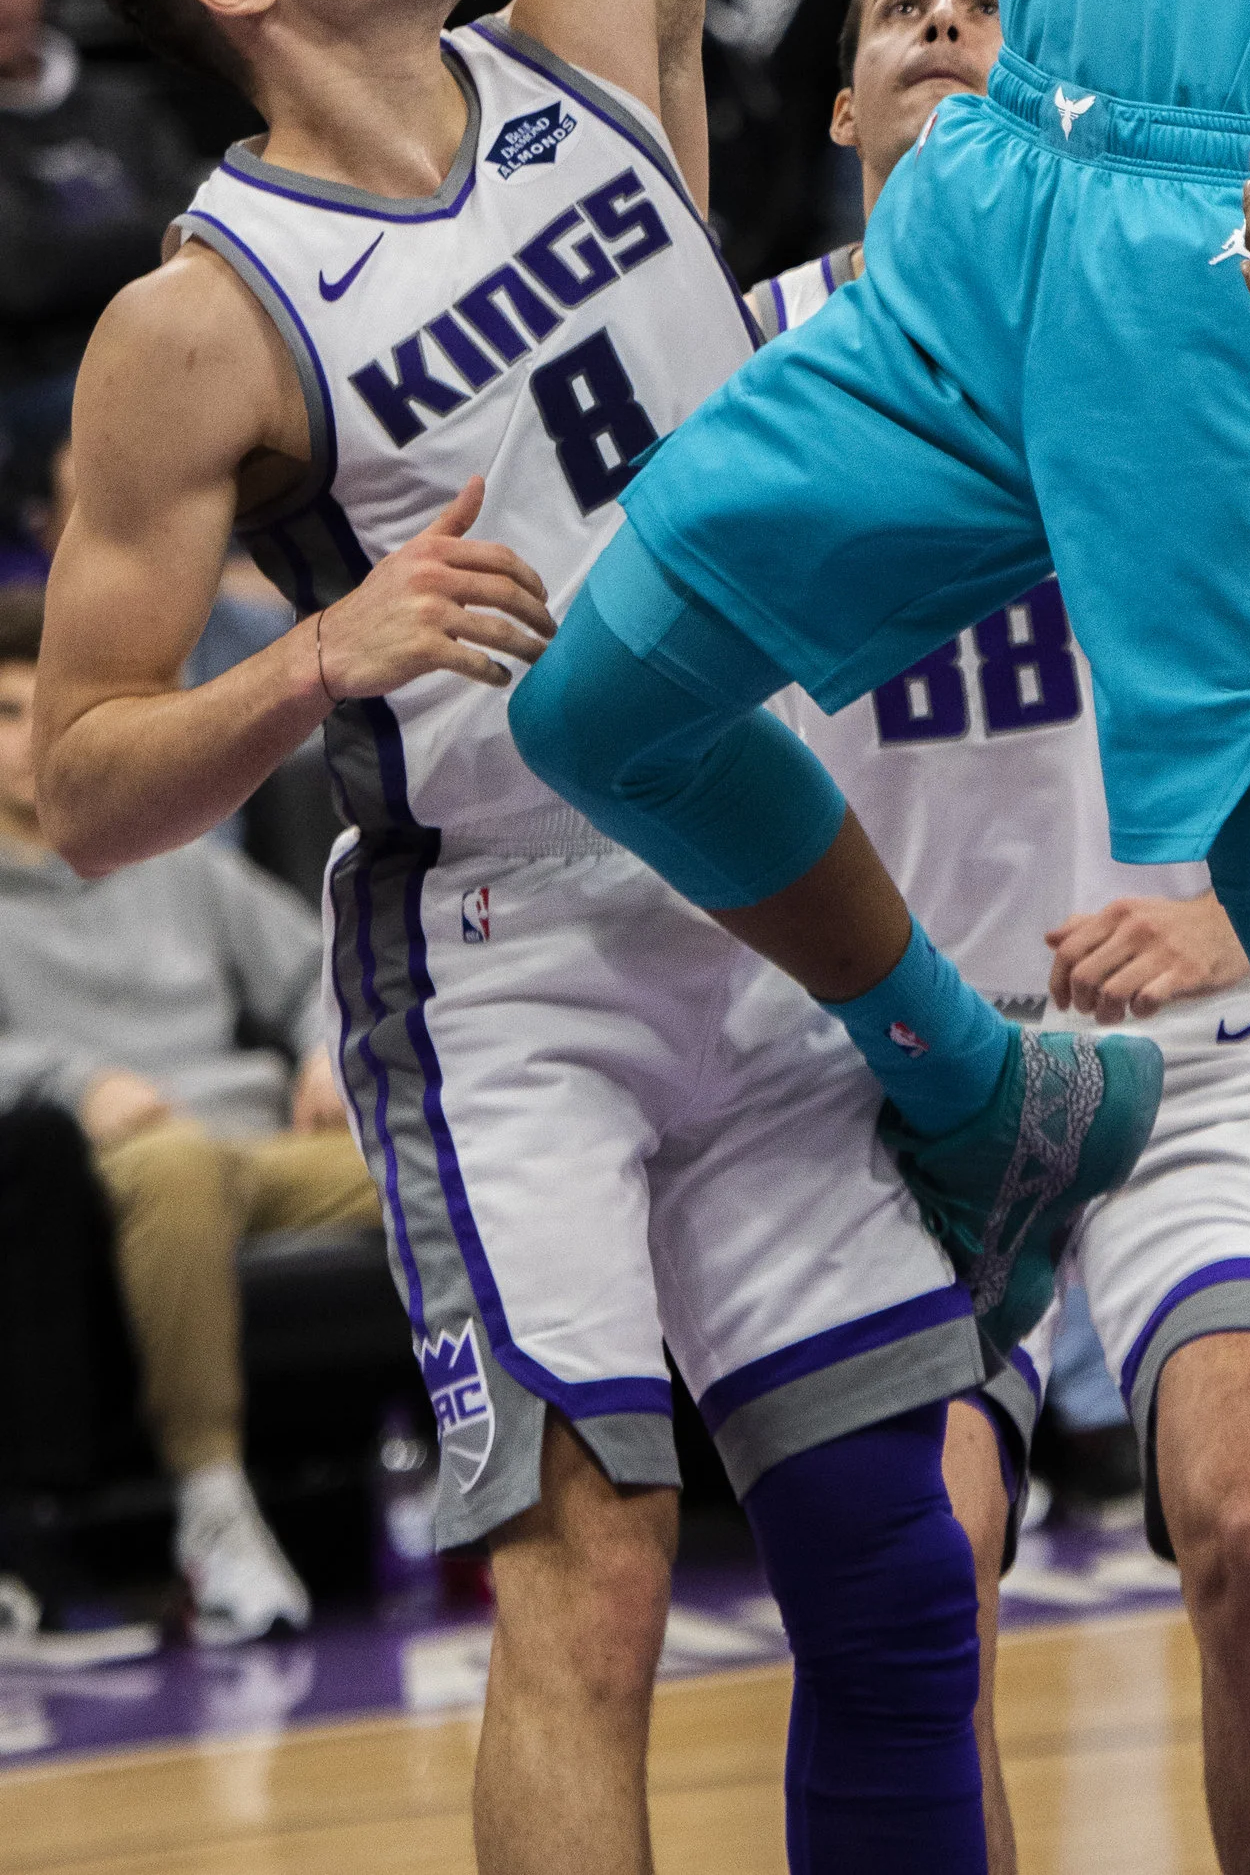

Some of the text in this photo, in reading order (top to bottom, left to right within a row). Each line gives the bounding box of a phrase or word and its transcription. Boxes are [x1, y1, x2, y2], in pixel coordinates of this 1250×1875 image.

[499, 117, 576, 179] ALMONDS
[349, 165, 673, 450] KINGS
[529, 325, 662, 518] 8
[433, 1380, 488, 1433] AC
